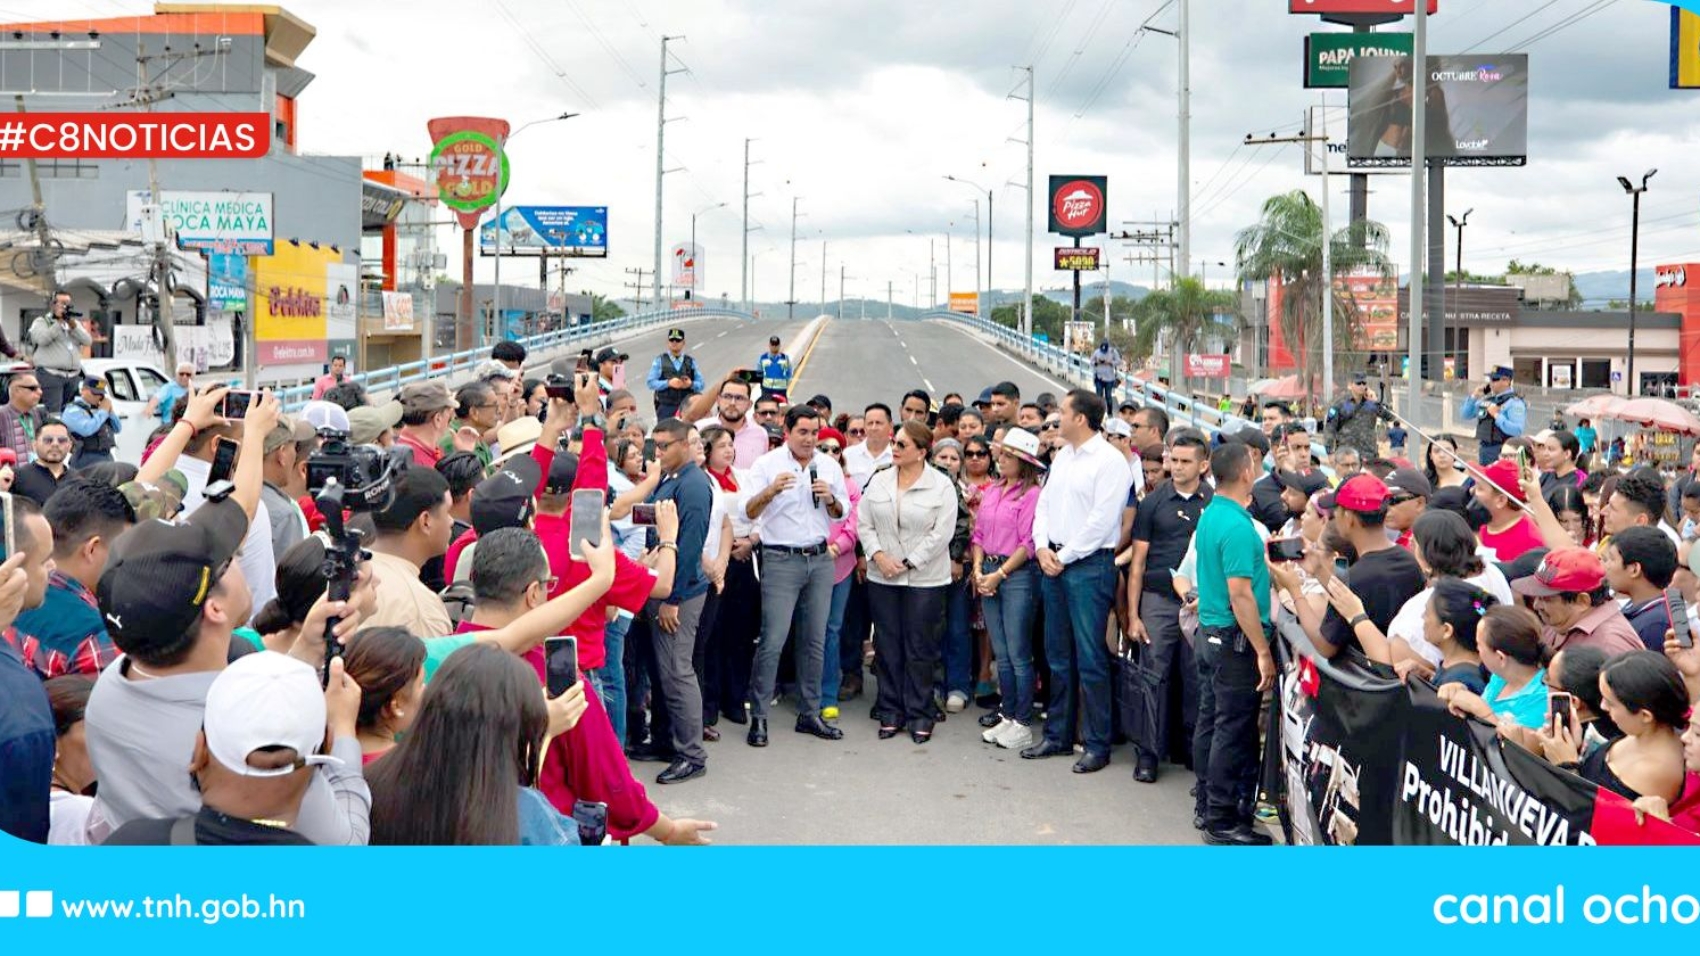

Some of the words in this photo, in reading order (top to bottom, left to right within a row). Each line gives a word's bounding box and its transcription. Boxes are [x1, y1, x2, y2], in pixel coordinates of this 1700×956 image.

[1319, 48, 1355, 64] PAPA
[1431, 71, 1477, 81] OCTUBRE
[454, 143, 483, 152] GOLD
[432, 154, 498, 178] PIZZA
[1062, 200, 1091, 213] Pizza
[1067, 208, 1090, 220] Hut
[216, 216, 267, 231] MAYA
[1445, 312, 1479, 320] NUSTRA
[1481, 312, 1511, 320] RECETA
[1439, 735, 1569, 845] VILLANUEVA
